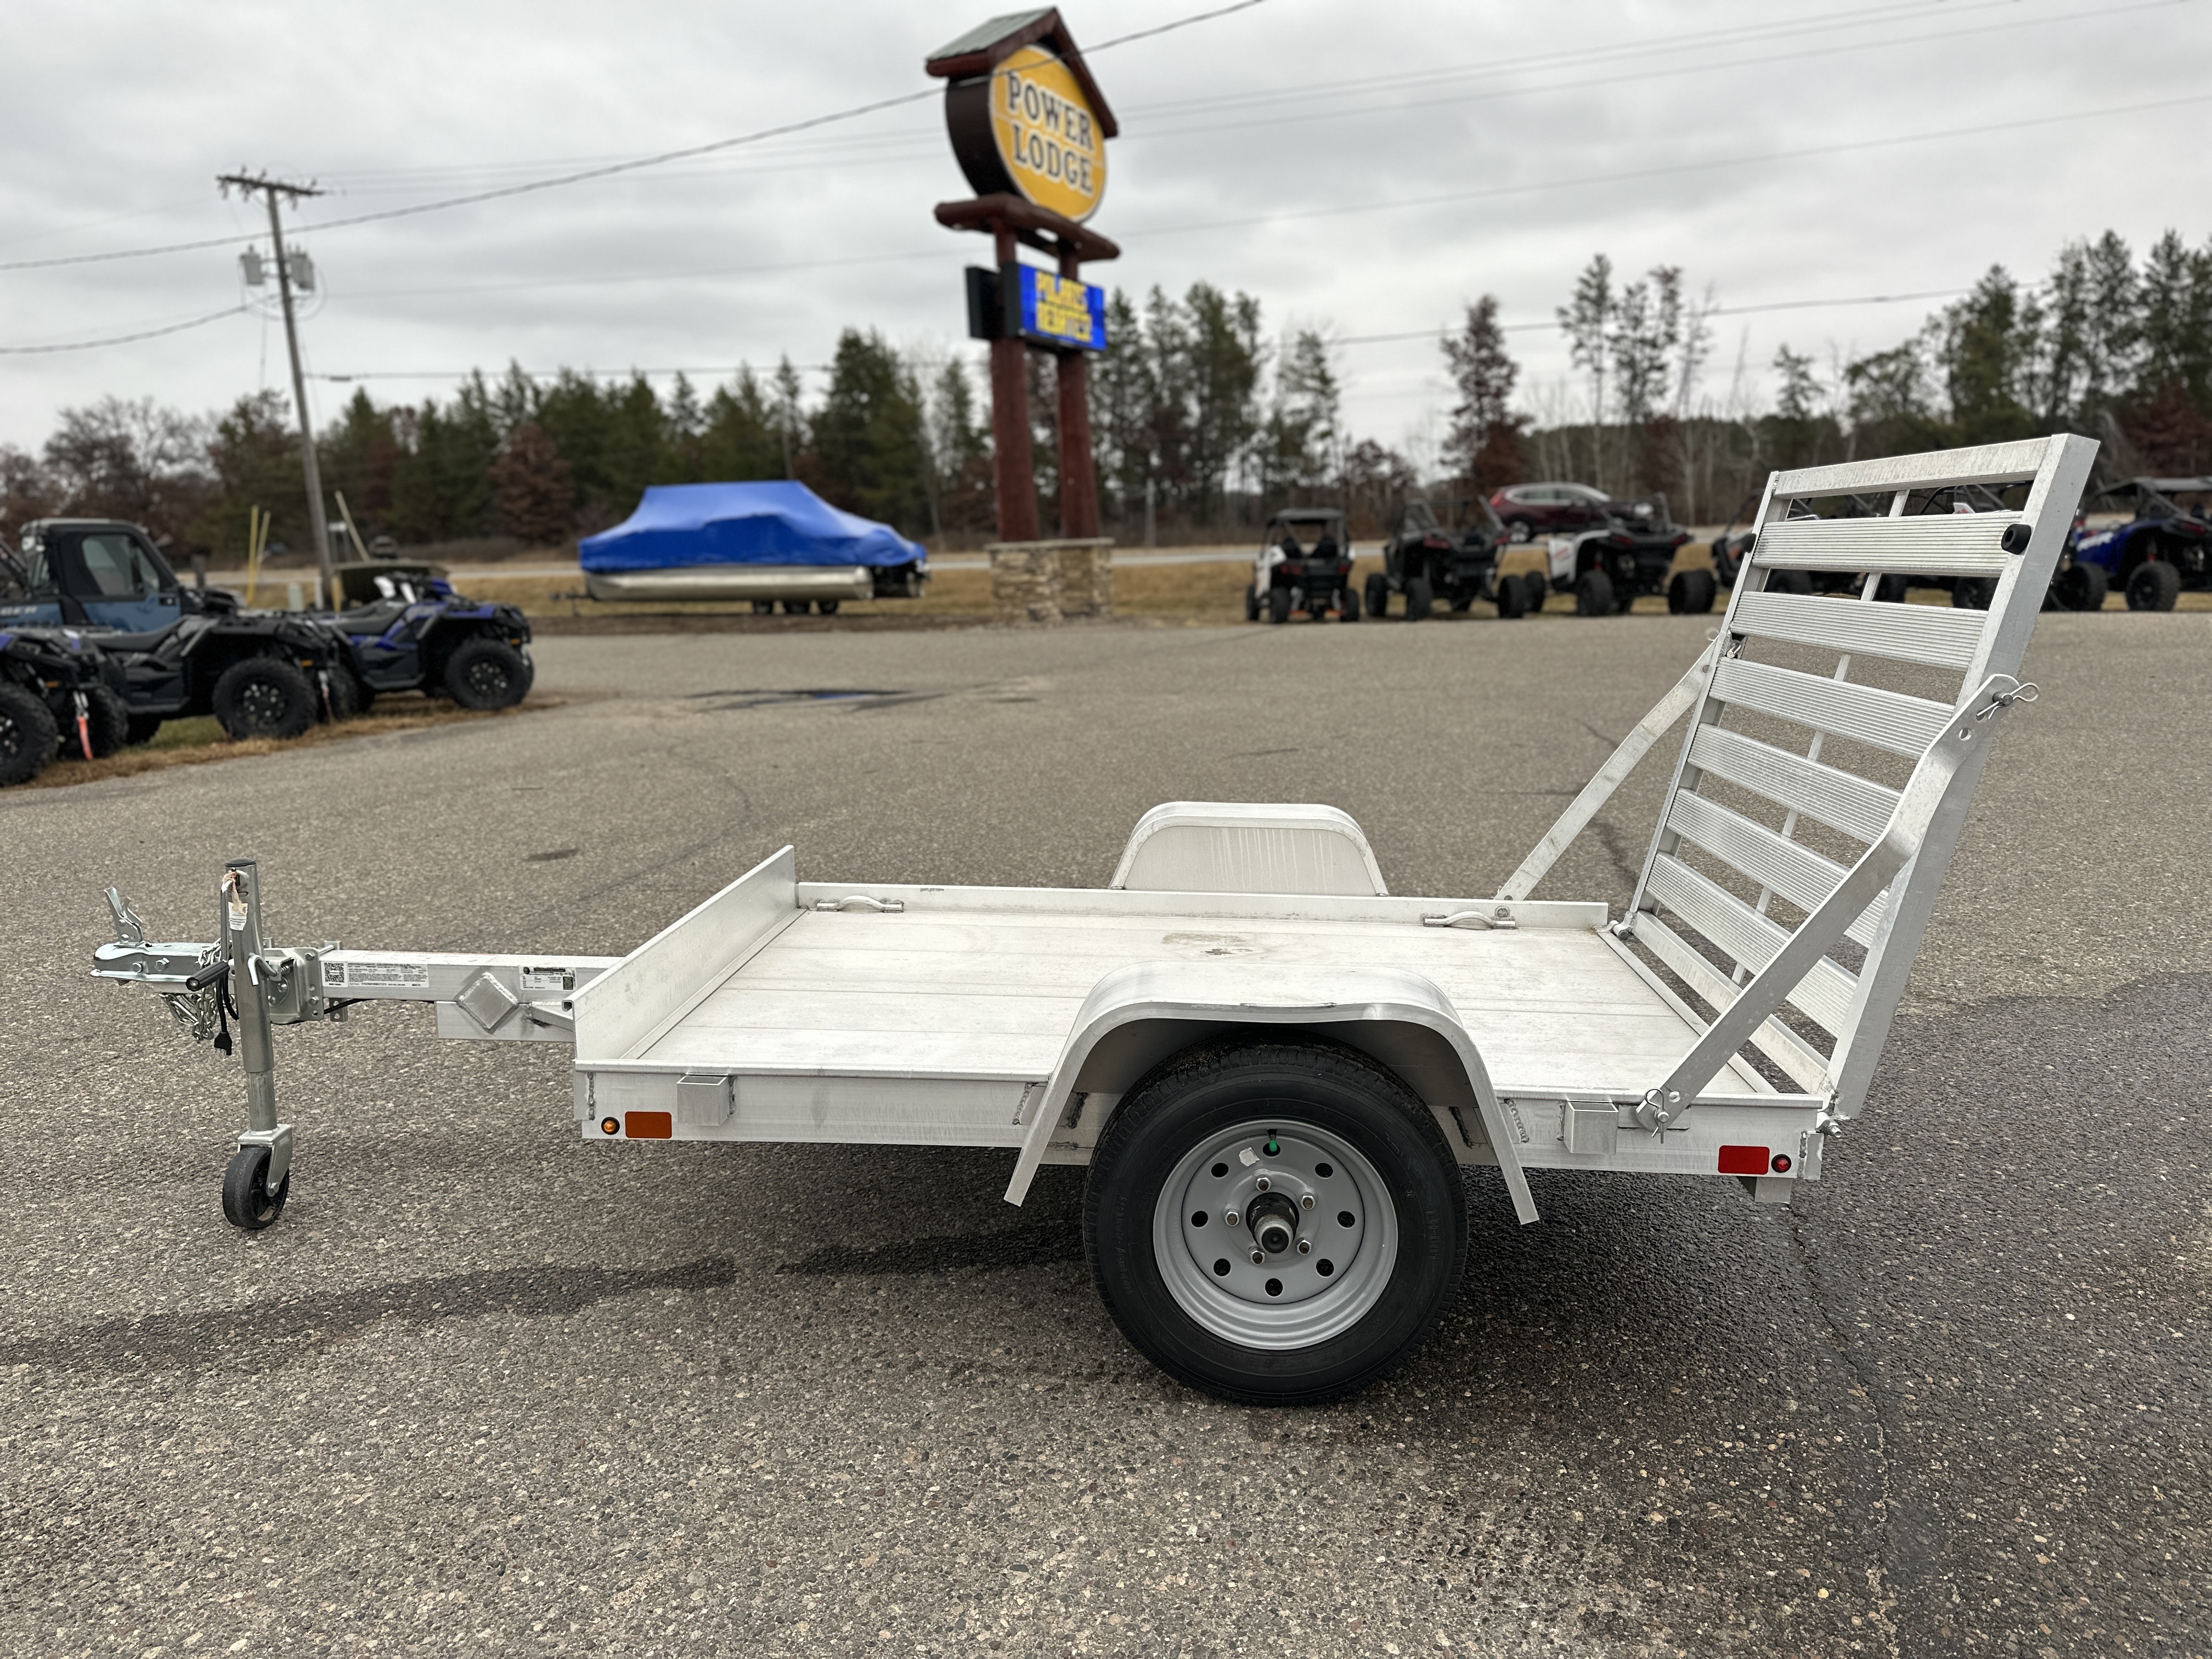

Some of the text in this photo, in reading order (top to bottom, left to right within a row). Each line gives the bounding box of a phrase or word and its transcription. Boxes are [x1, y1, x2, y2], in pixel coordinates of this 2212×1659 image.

[1007, 71, 1093, 151] POWER
[1013, 124, 1093, 192] LODGE
[1426, 1210, 1440, 1260] LH-001
